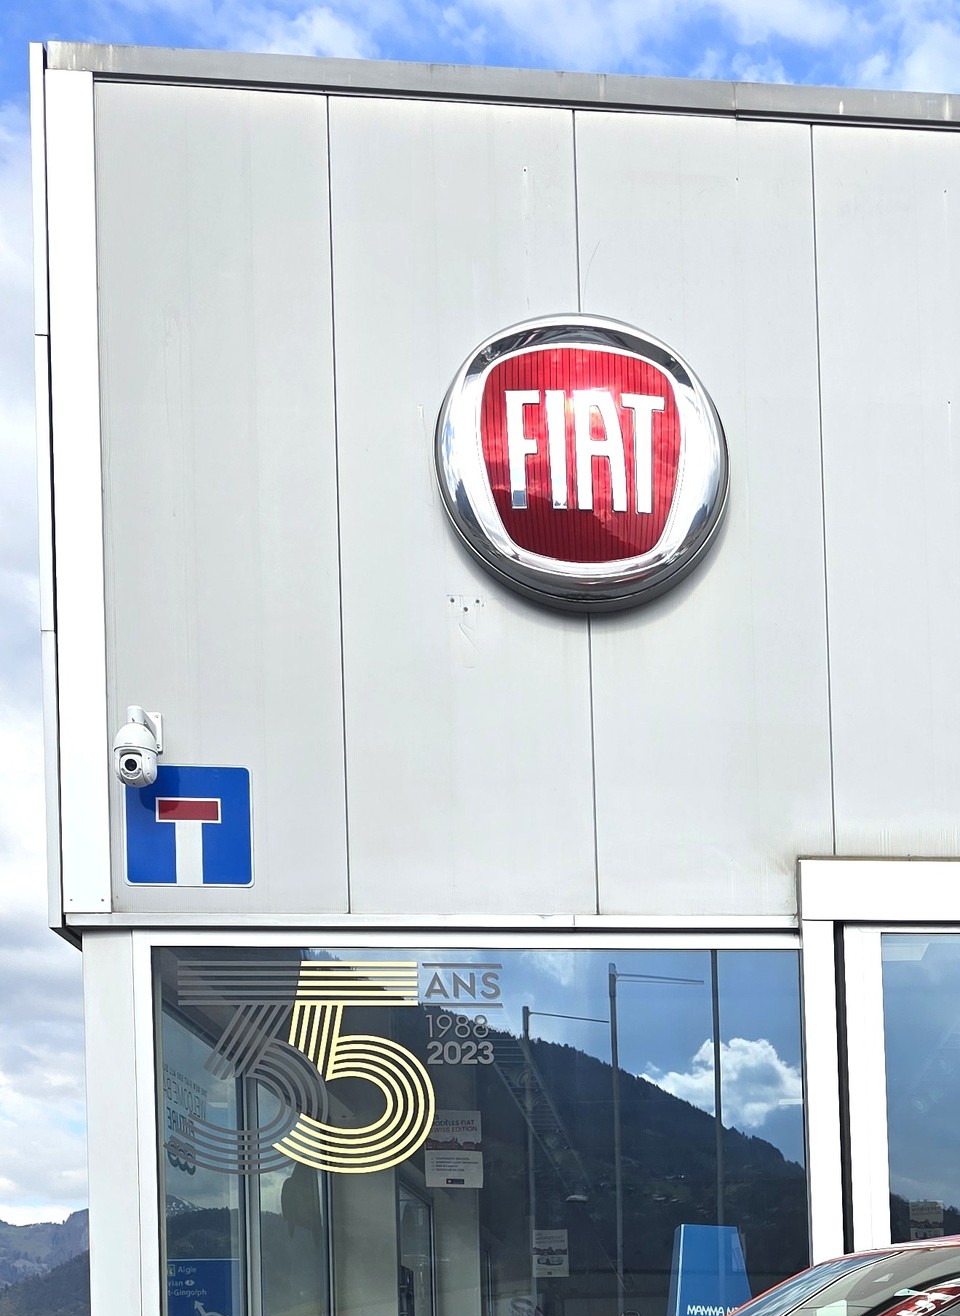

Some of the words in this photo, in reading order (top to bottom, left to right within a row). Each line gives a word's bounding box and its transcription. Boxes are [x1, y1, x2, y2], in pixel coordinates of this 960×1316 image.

[504, 388, 665, 515] FIAT
[424, 971, 501, 1000] ANS
[425, 1013, 490, 1039] 1988
[426, 1040, 496, 1066] 2023
[163, 960, 436, 1175] 35
[435, 1118, 460, 1127] ODÈLES
[167, 1288, 207, 1298] t-Gingolph
[686, 1304, 725, 1316] MAMMA
